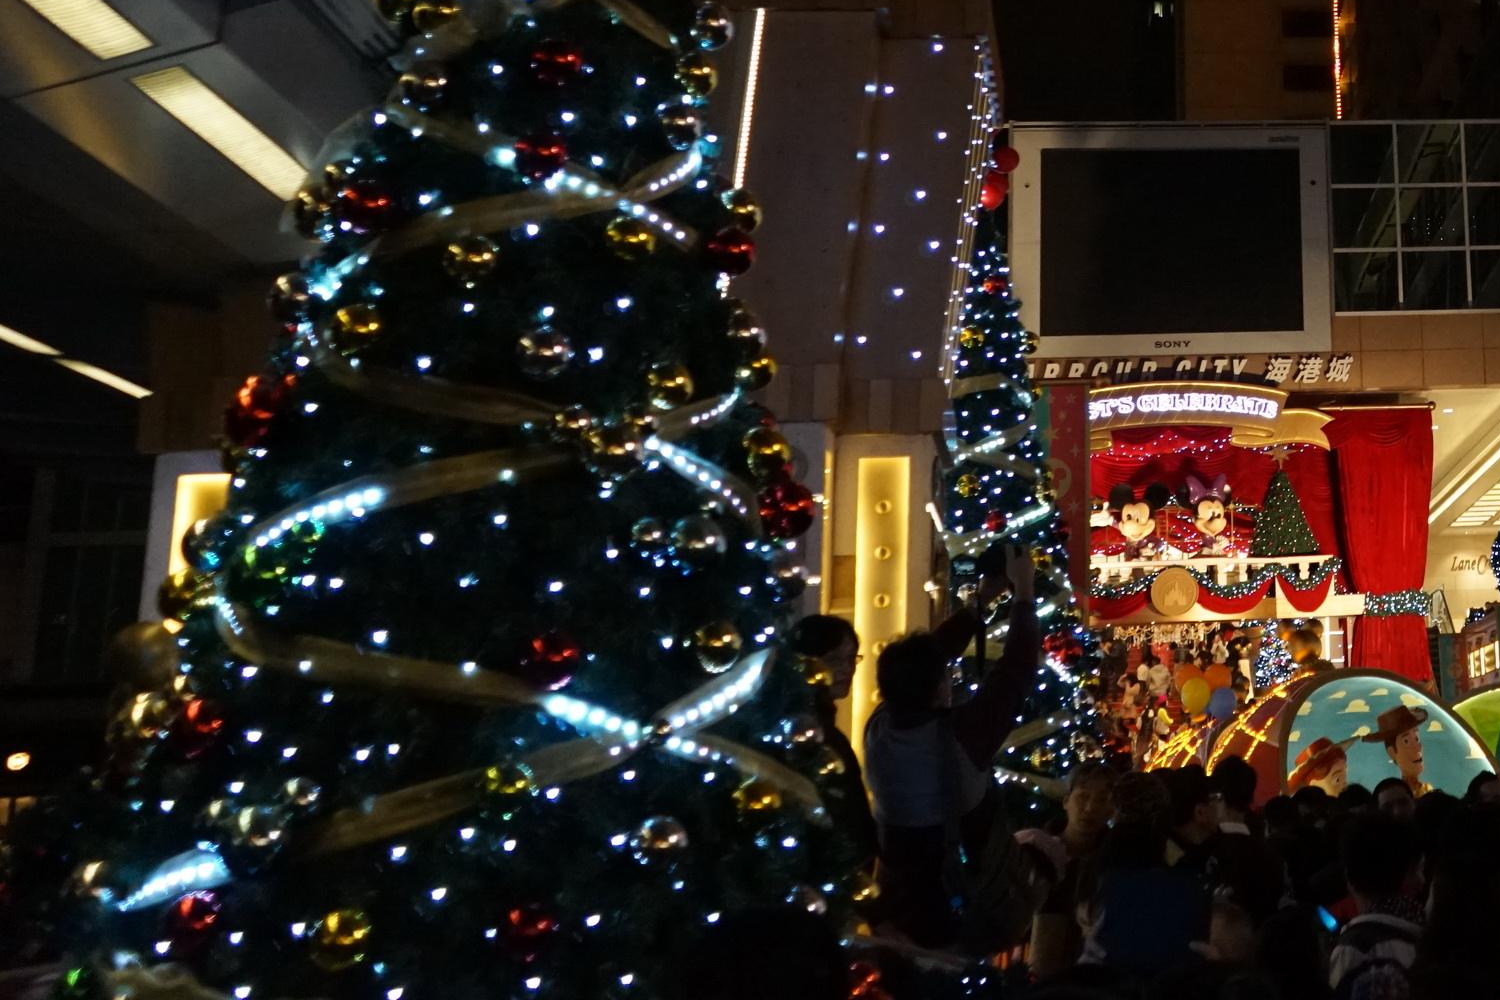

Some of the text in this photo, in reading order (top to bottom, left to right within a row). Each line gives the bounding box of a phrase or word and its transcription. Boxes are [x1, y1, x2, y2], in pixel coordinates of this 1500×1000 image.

[1265, 355, 1354, 383] 海港城
[1137, 393, 1279, 418] CELEBRATE
[1450, 556, 1477, 571] Lane
